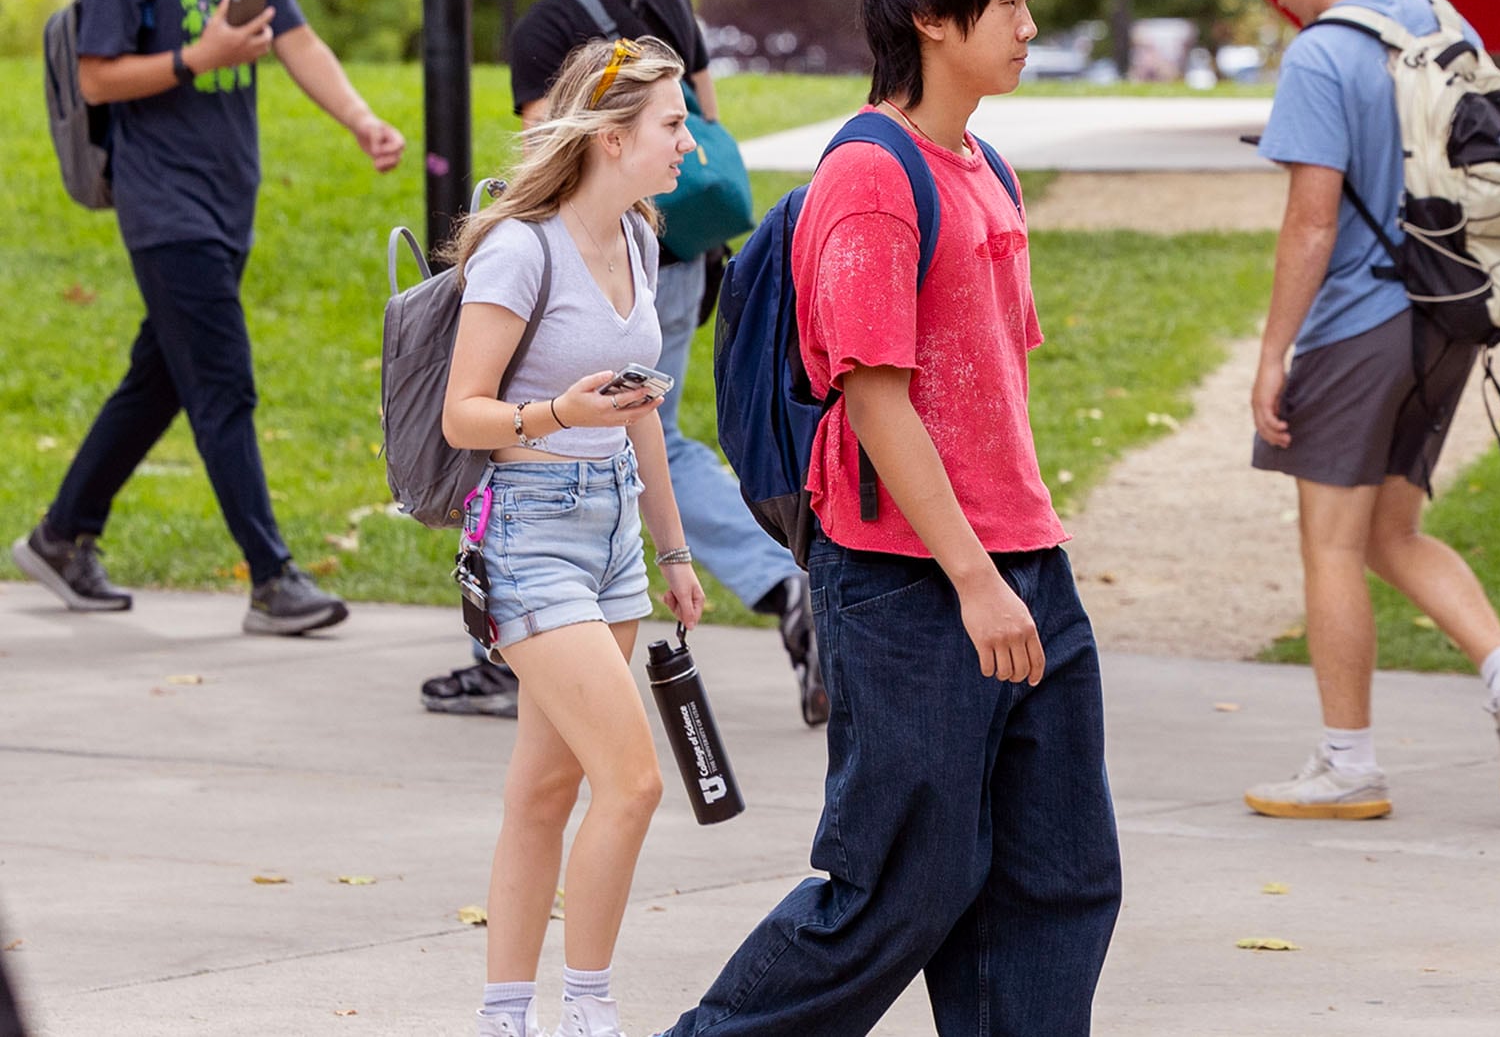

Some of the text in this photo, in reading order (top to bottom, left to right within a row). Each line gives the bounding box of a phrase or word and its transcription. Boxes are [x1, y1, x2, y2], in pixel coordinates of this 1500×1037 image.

[680, 705, 709, 776] College of Science
[709, 760, 718, 773] THE
[698, 775, 727, 804] U
